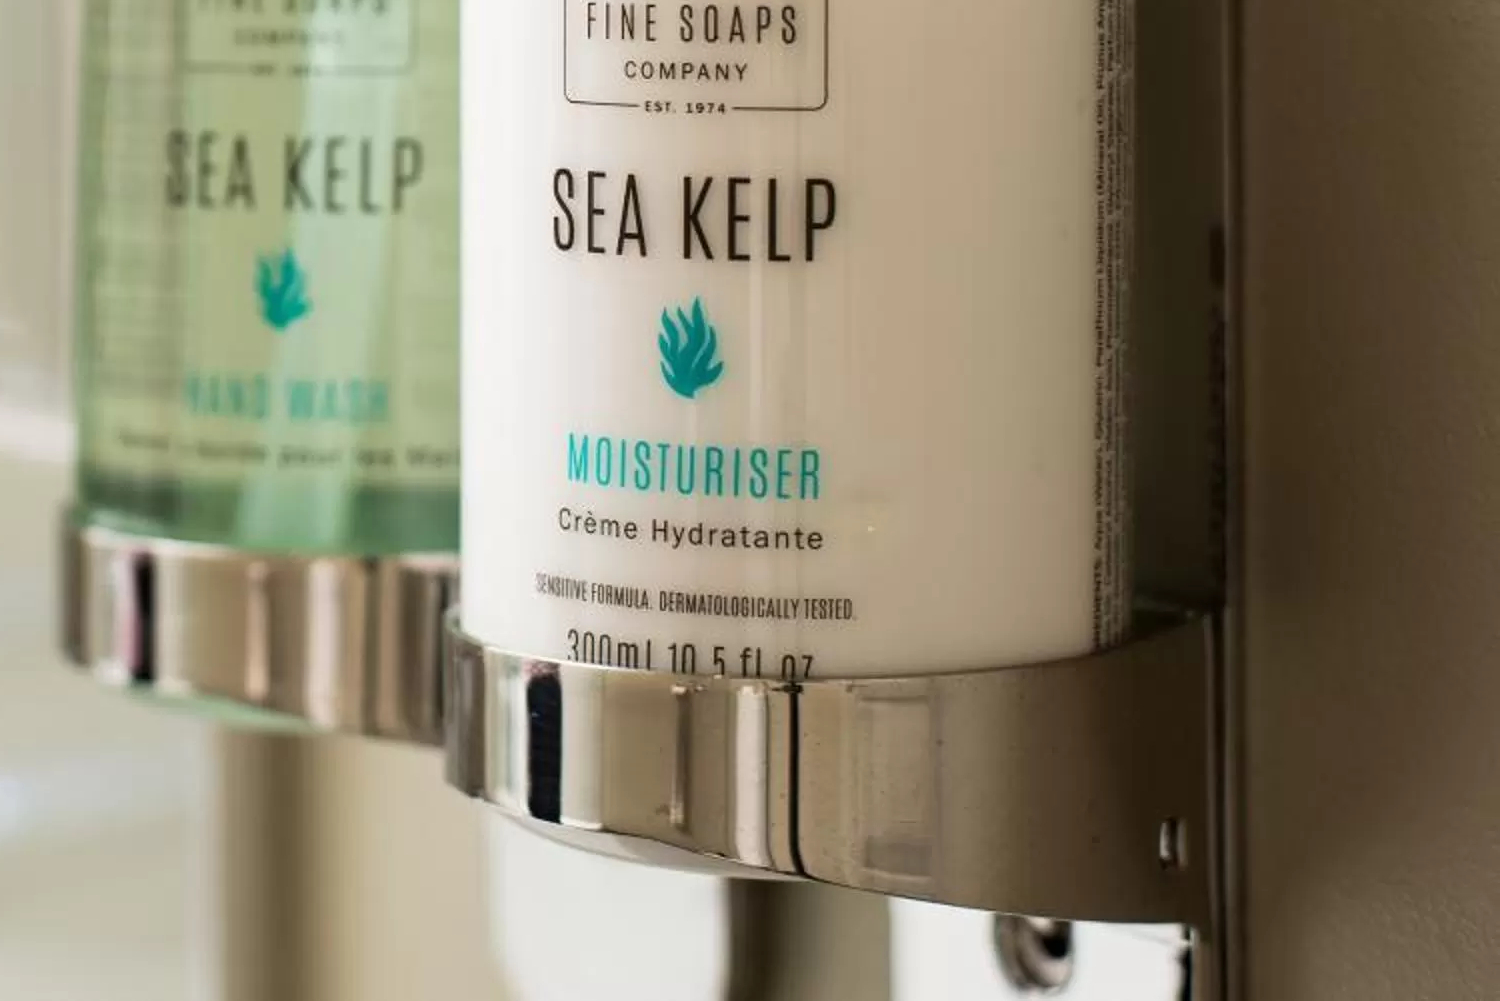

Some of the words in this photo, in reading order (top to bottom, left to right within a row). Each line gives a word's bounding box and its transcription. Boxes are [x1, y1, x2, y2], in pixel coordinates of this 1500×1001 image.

[586, 2, 657, 42] FINE
[679, 4, 797, 45] SOAPS
[623, 61, 748, 82] COMPANY
[644, 100, 677, 114] EST.
[684, 101, 727, 115] 1974
[165, 128, 258, 212] SEA
[283, 134, 425, 216] KELP
[552, 167, 648, 258] SEA
[683, 175, 837, 263] KELP
[566, 431, 821, 500] MOISTURISER
[557, 506, 638, 541] Crème
[651, 518, 824, 551] Hydratante
[535, 572, 588, 602] SENSITIVE
[659, 590, 799, 620] DERMATOLOGICALLY
[803, 598, 857, 621] TESTED.
